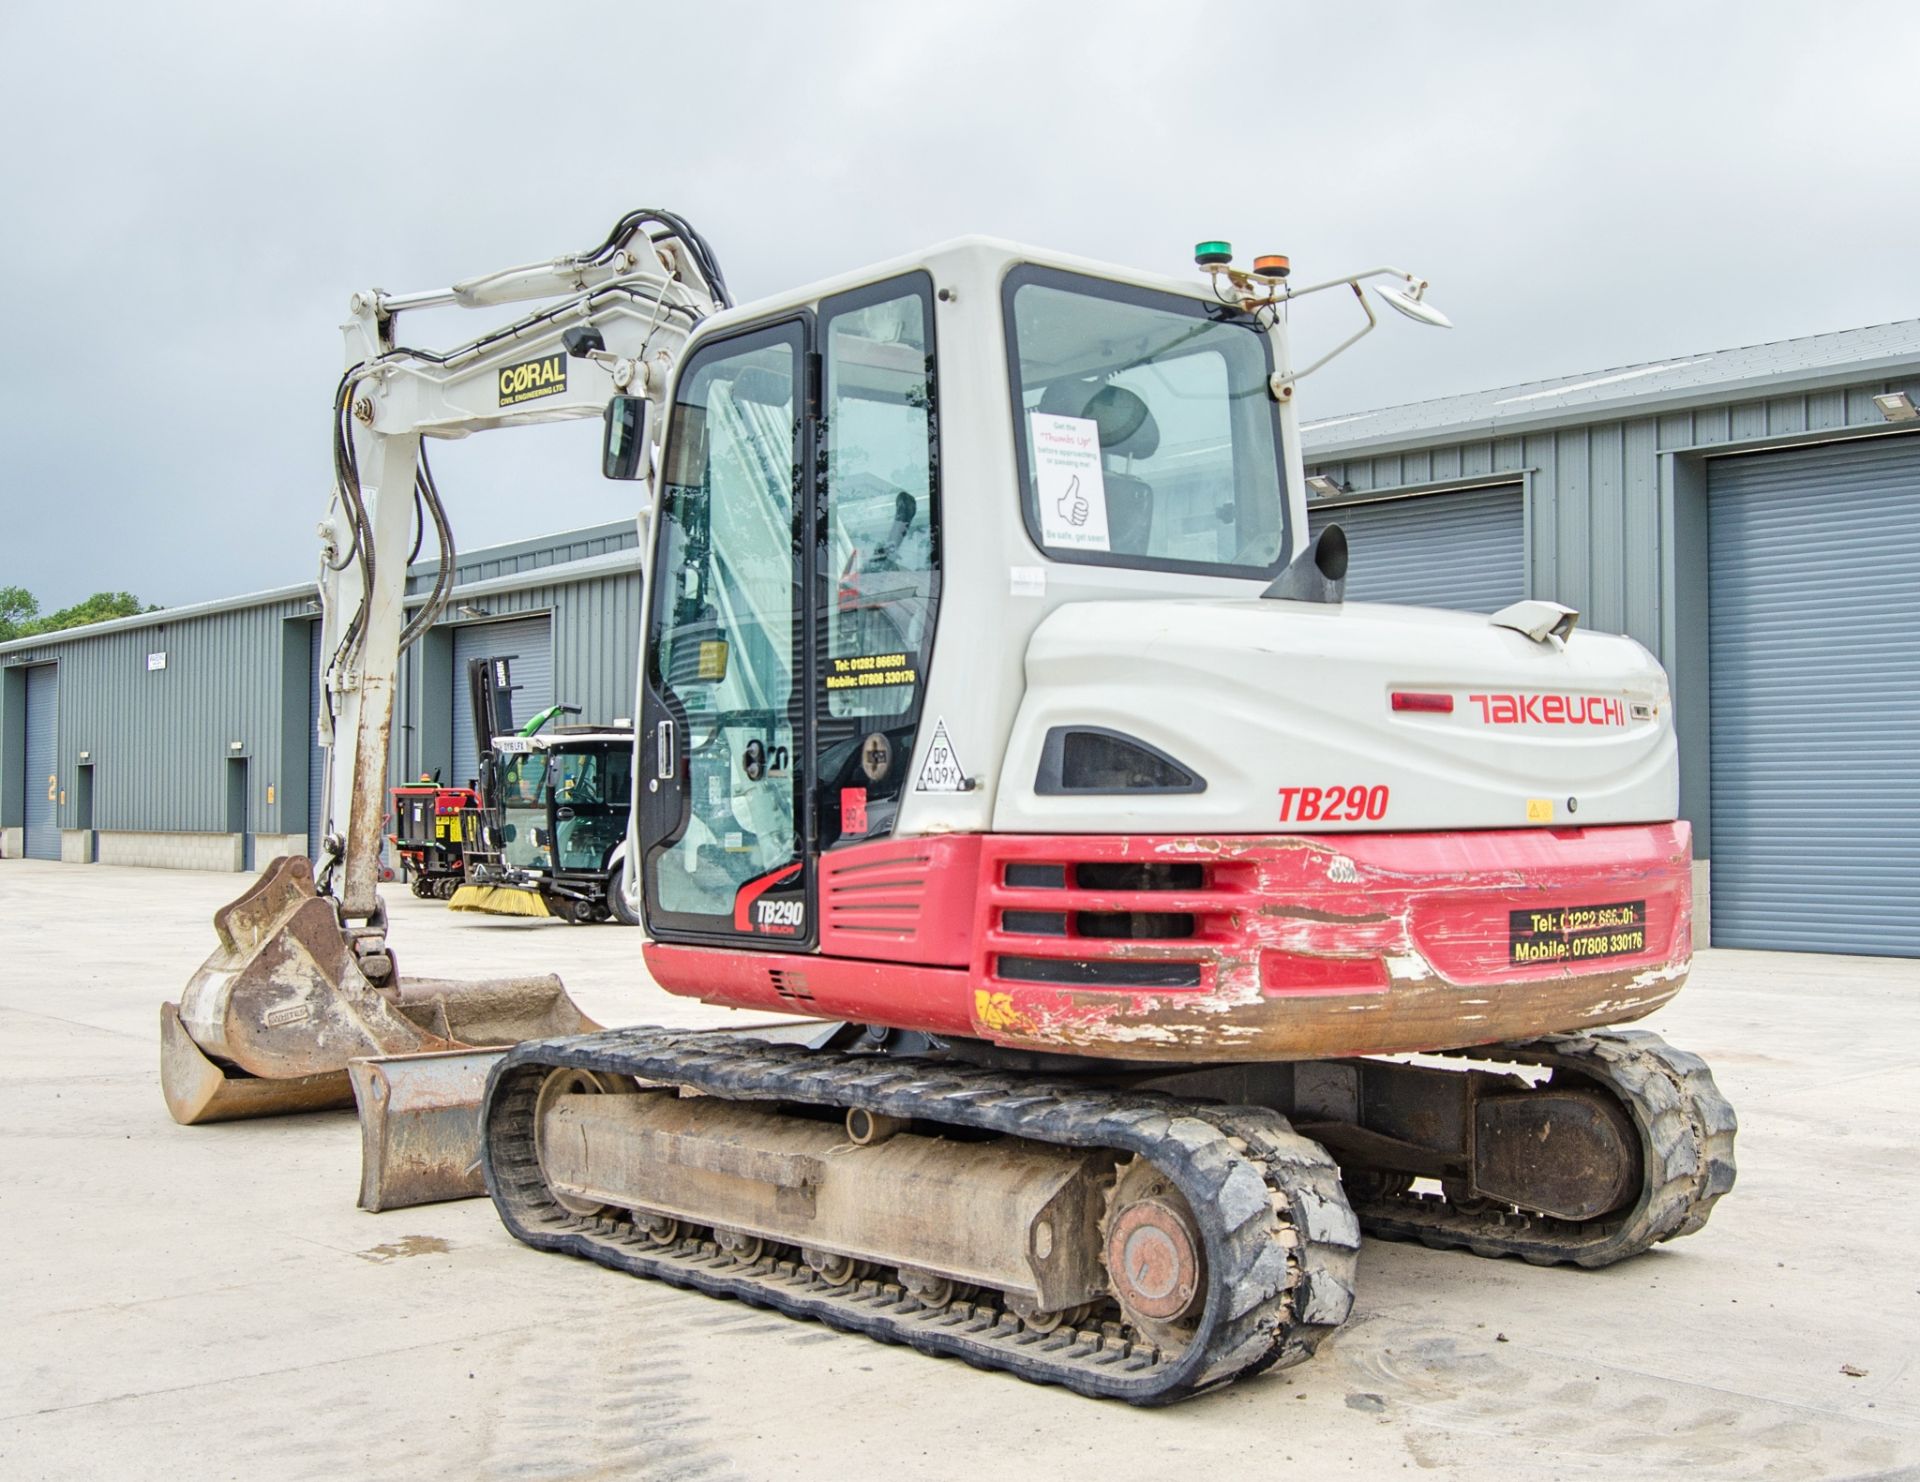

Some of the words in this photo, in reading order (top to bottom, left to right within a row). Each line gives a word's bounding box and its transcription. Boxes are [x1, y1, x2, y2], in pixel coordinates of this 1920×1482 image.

[515, 387, 552, 401] ENGINEERING
[1038, 446, 1057, 454] before
[826, 675, 858, 688] Mobile:
[48, 775, 57, 800] 2
[1278, 785, 1389, 821] TB290
[757, 901, 804, 926] TB290
[1531, 913, 1557, 933] Tel:
[1515, 940, 1570, 961] Mobile:
[1573, 935, 1608, 956] 07808
